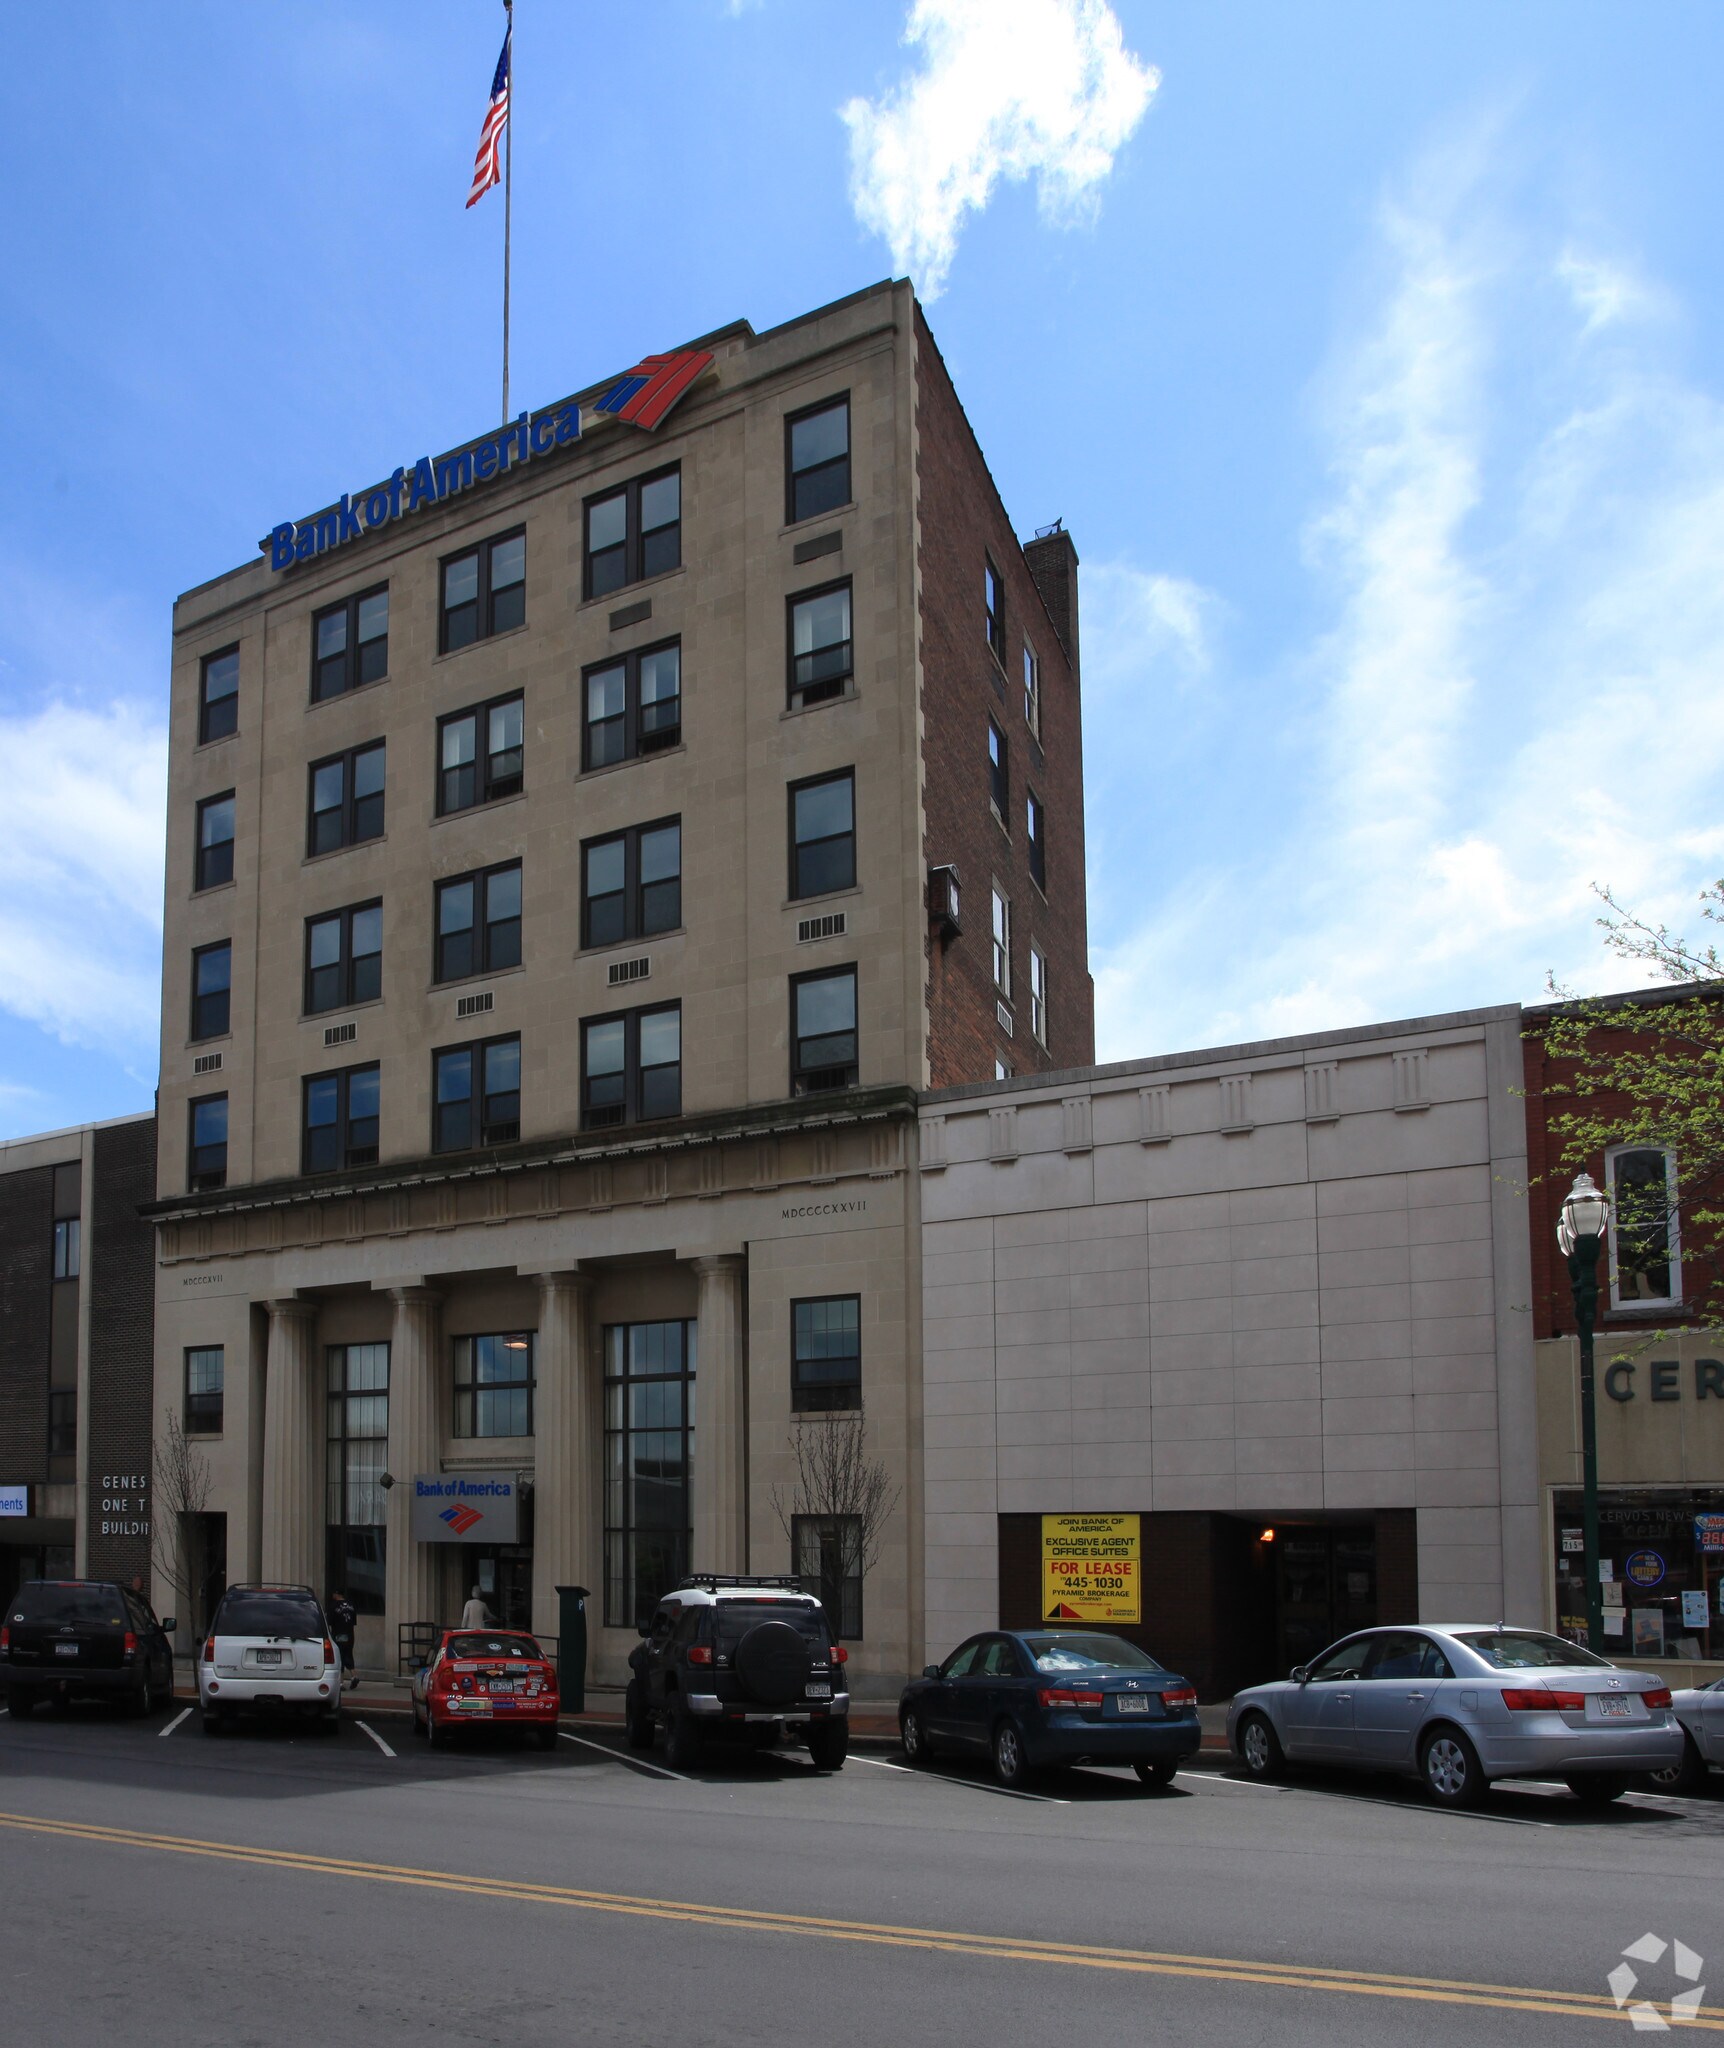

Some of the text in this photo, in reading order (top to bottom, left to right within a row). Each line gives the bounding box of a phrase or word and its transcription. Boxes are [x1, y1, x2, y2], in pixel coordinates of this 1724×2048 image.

[271, 402, 583, 572] Bank of America
[781, 1200, 866, 1219] MDCCCCXXVII
[183, 1274, 223, 1286] MDCCCXVII
[1604, 1361, 1724, 1401] CER
[103, 1475, 146, 1489] GENES
[416, 1480, 511, 1497] Bank of America
[102, 1498, 146, 1512] ONE T
[1656, 1510, 1694, 1522] NEWS
[1045, 1538, 1135, 1546] EXCLUSIVE AGENT
[1052, 1548, 1129, 1556] OFFICE SUITES
[1051, 1562, 1132, 1575] FOR LEASE
[1064, 1577, 1123, 1588] 445-1030
[578, 1599, 584, 1611] P
